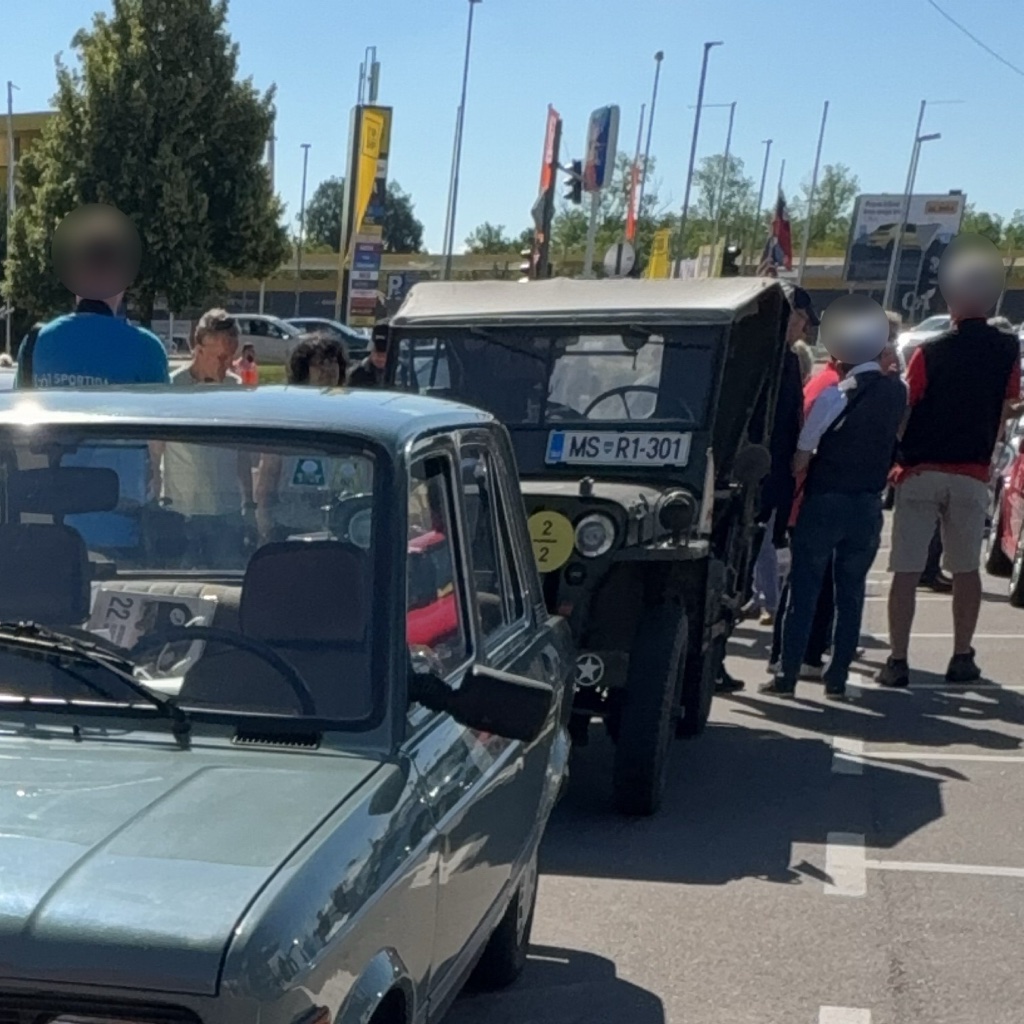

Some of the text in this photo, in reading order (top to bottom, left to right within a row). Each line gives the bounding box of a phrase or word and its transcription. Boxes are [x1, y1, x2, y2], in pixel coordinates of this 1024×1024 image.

[569, 436, 681, 460] MS R1-301
[542, 520, 553, 536] 2
[538, 547, 549, 562] 2
